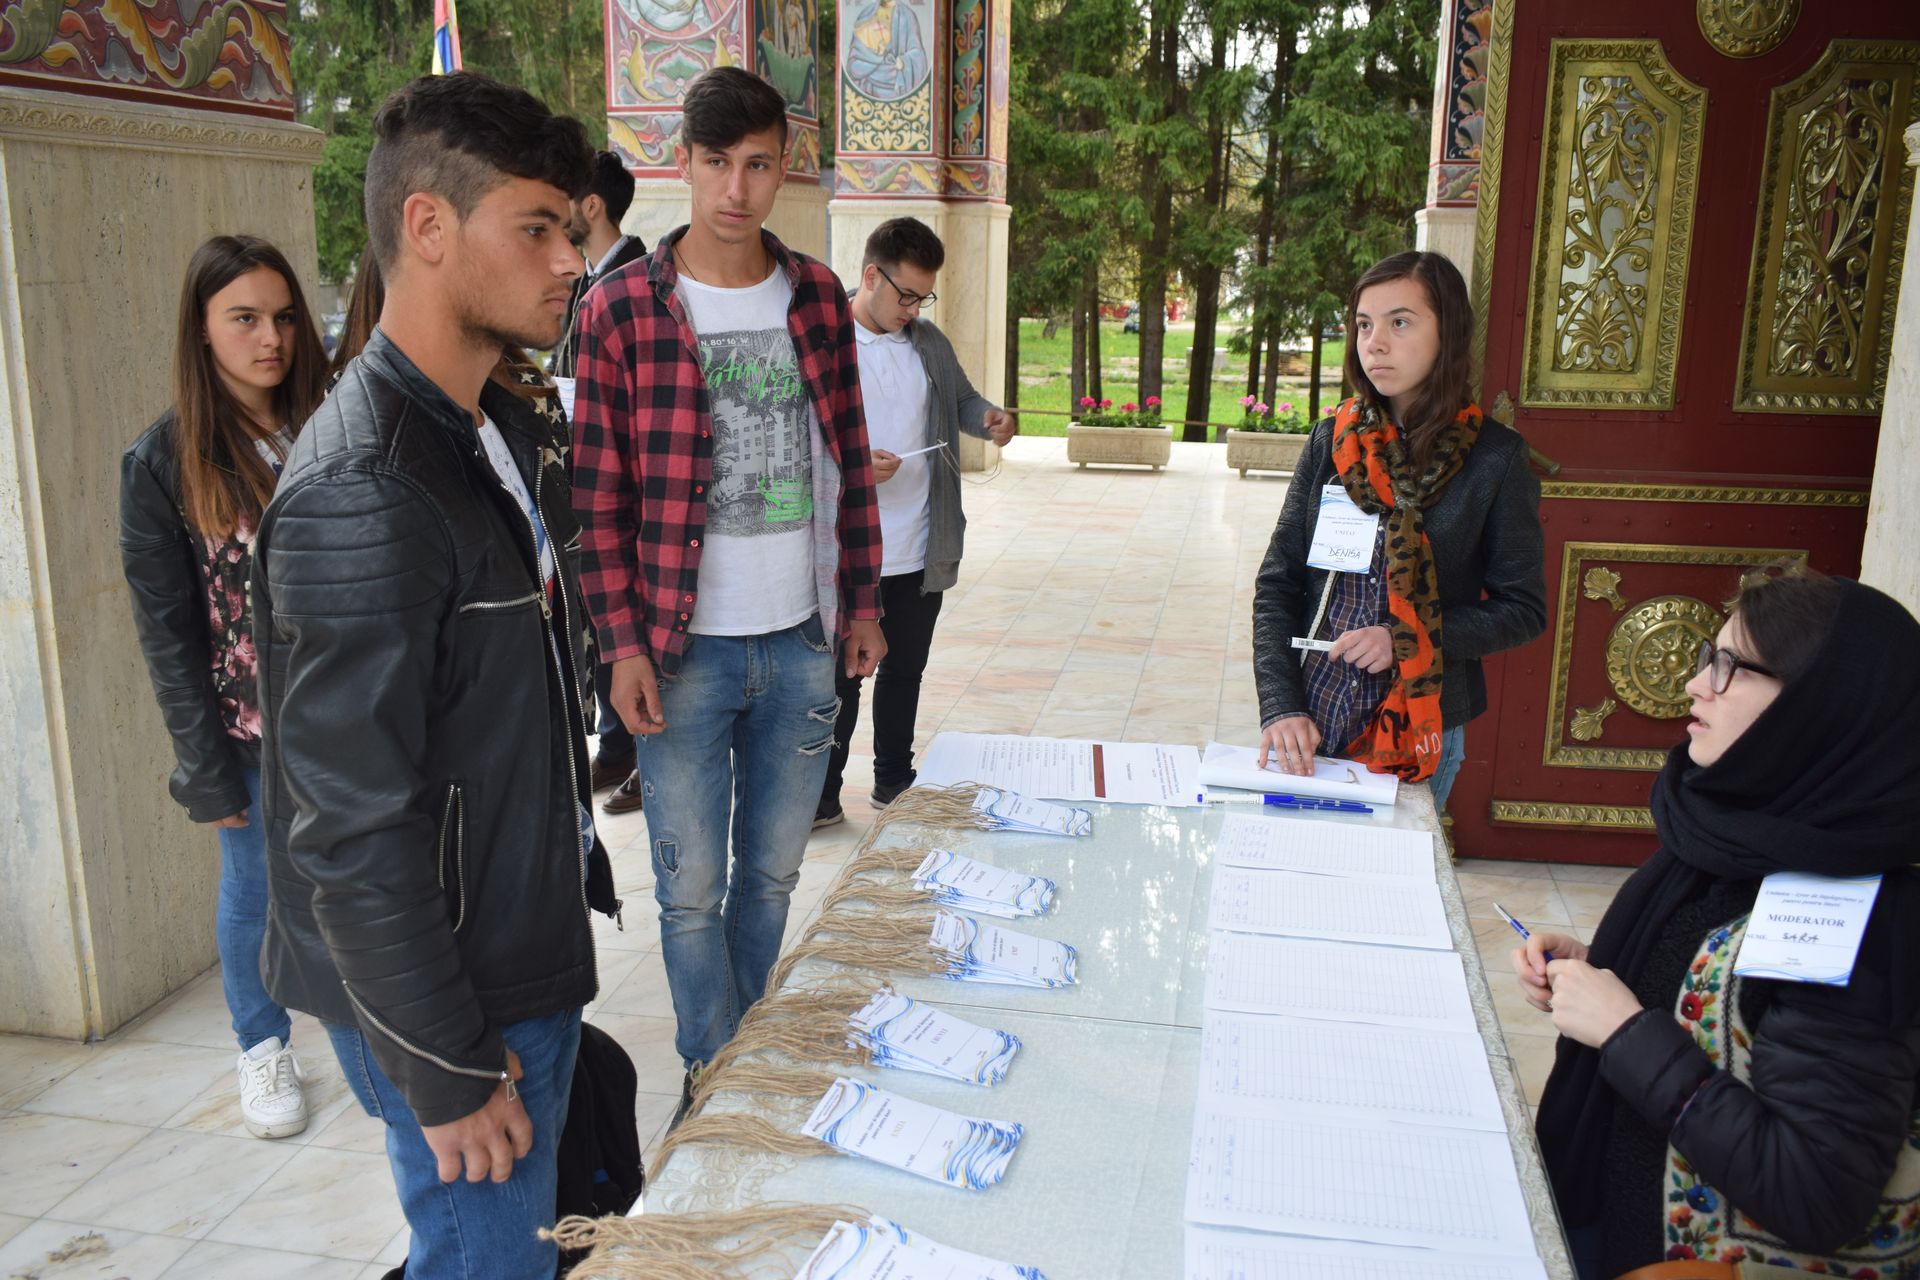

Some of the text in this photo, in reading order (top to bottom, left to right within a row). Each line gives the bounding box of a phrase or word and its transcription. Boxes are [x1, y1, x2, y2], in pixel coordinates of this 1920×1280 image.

[1328, 547, 1361, 559] DENISA
[1767, 913, 1846, 928] MODERATOR
[1781, 931, 1820, 943] SARA
